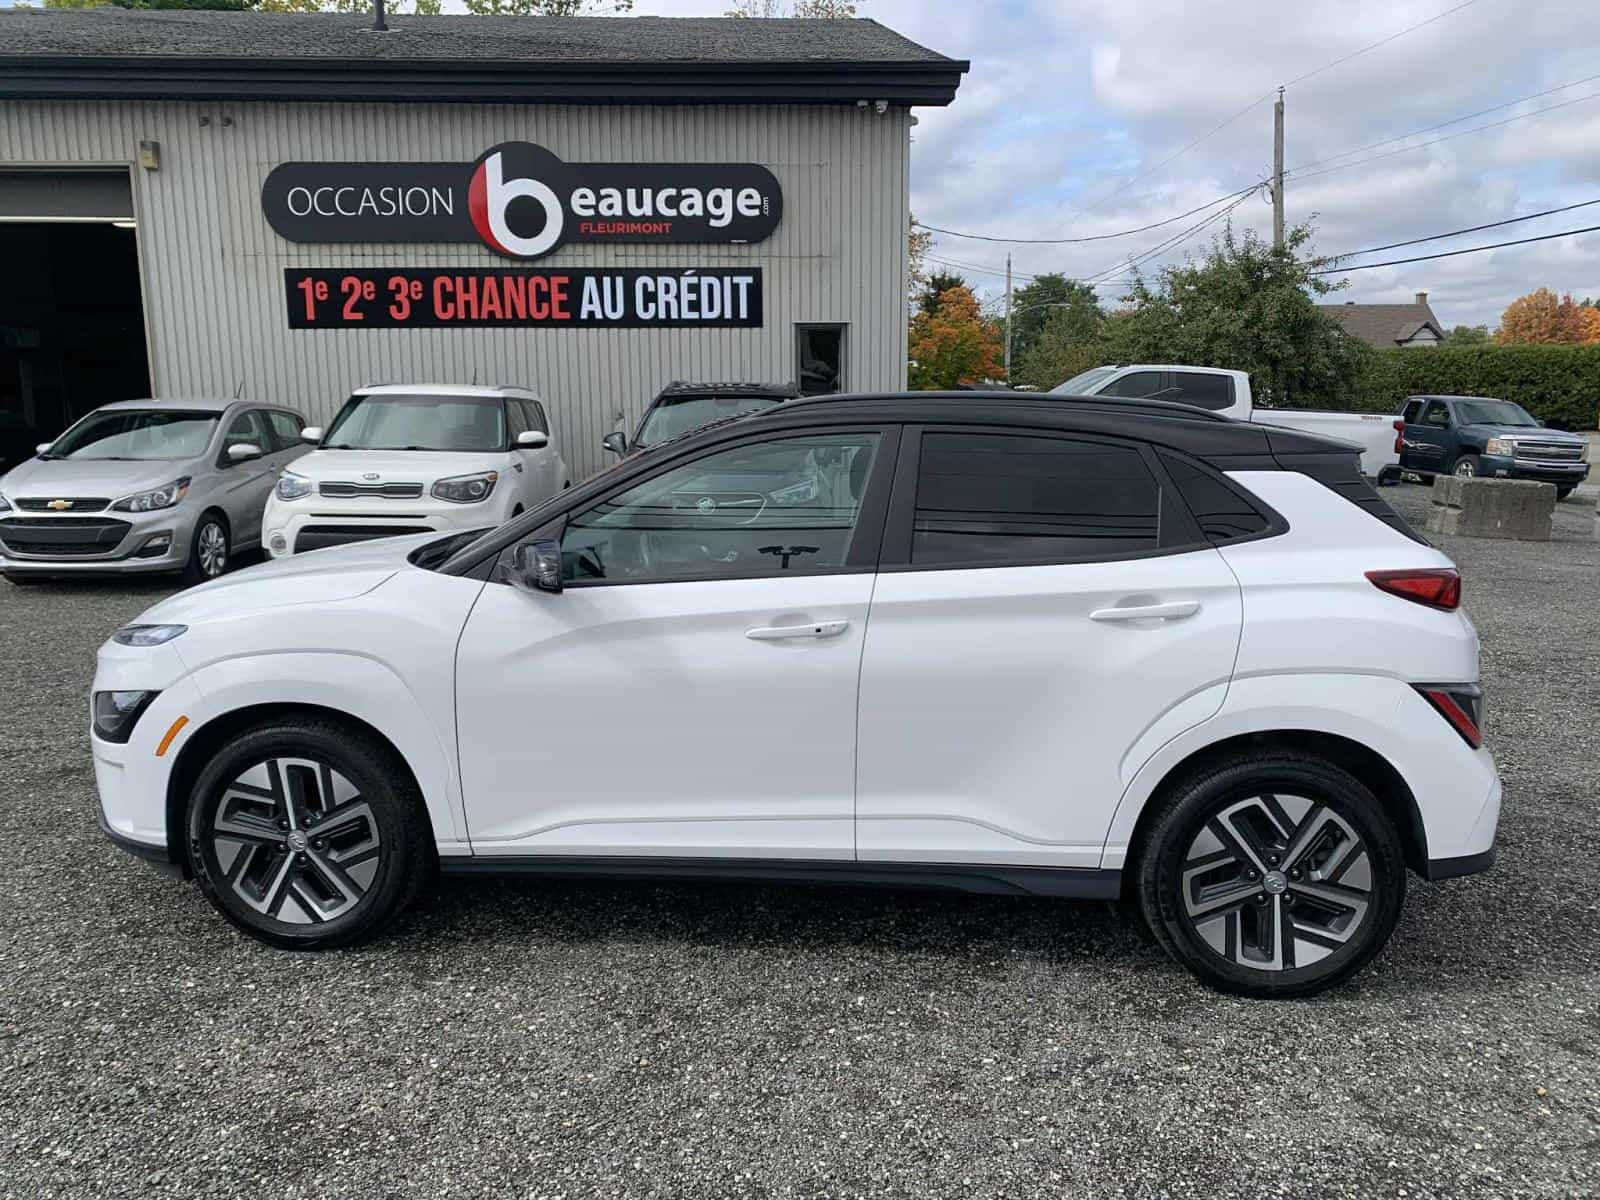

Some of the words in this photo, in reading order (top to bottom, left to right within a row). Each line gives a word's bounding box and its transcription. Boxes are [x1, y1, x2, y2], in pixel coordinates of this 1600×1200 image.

[287, 186, 454, 216] OCCASION
[580, 222, 673, 234] FLEURIMONT
[297, 276, 329, 320] 1e
[340, 276, 376, 320] 2e
[388, 276, 423, 320] 3e
[432, 276, 571, 320] CHANCE
[580, 276, 625, 320] AU
[634, 269, 754, 320] CRÉDIT
